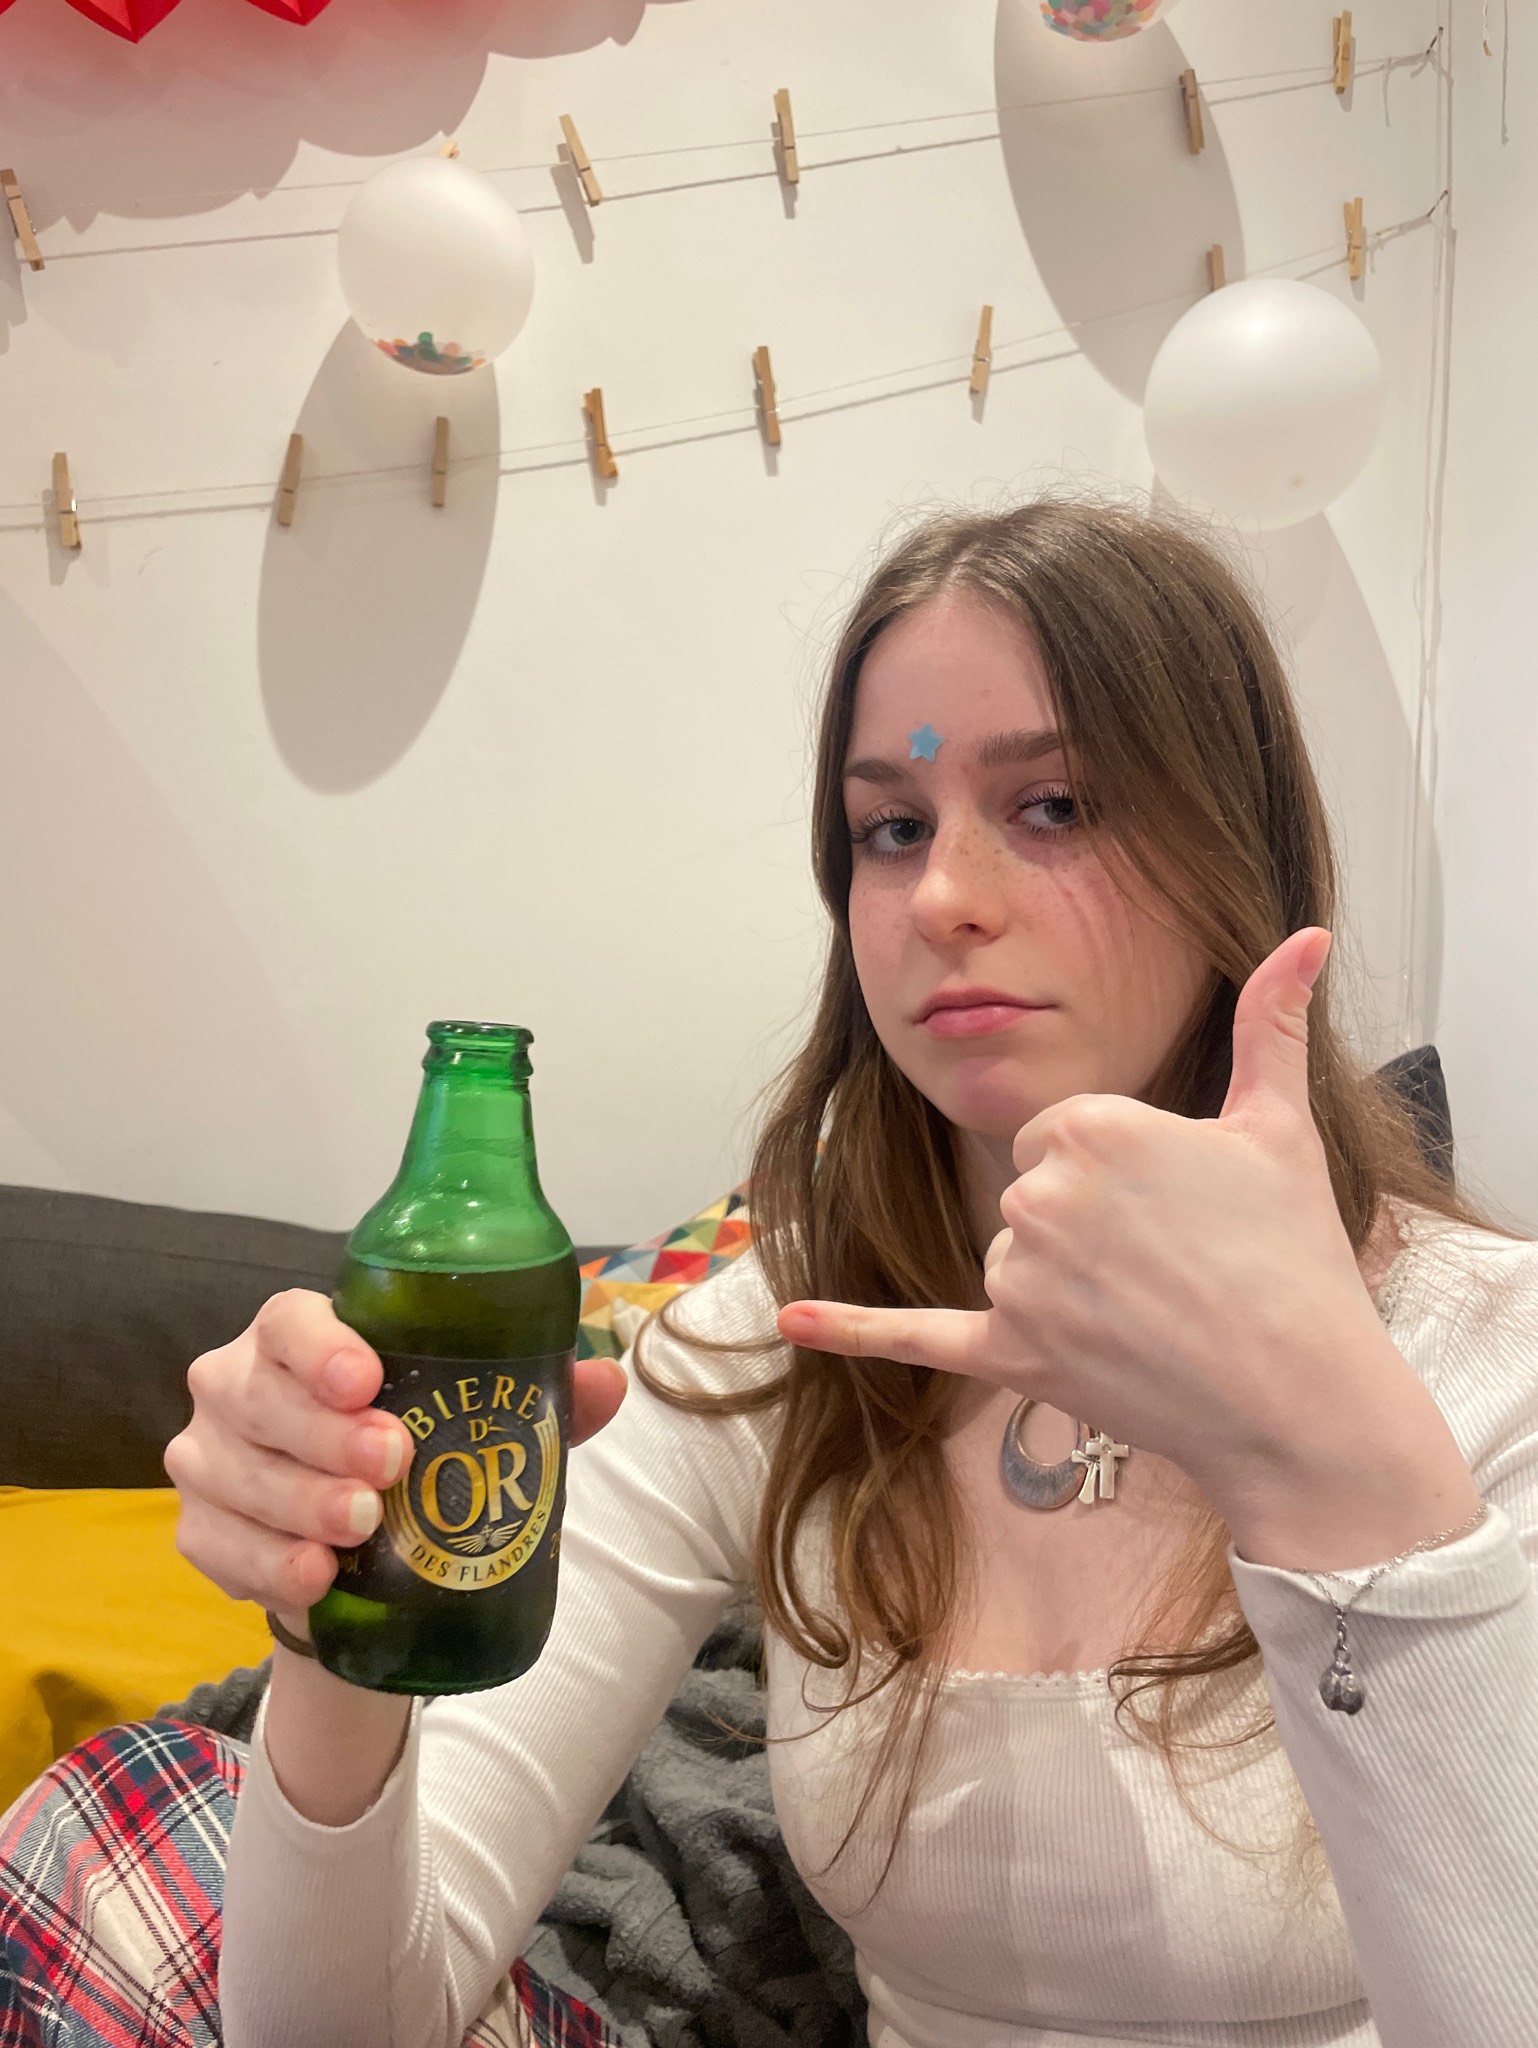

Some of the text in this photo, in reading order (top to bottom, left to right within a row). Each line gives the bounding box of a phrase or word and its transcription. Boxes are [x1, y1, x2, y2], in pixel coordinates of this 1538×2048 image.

[400, 1375, 543, 1441] BIERE
[421, 1441, 534, 1533] OR
[411, 1545, 452, 1578] DES
[460, 1510, 547, 1582] FLANDRES
